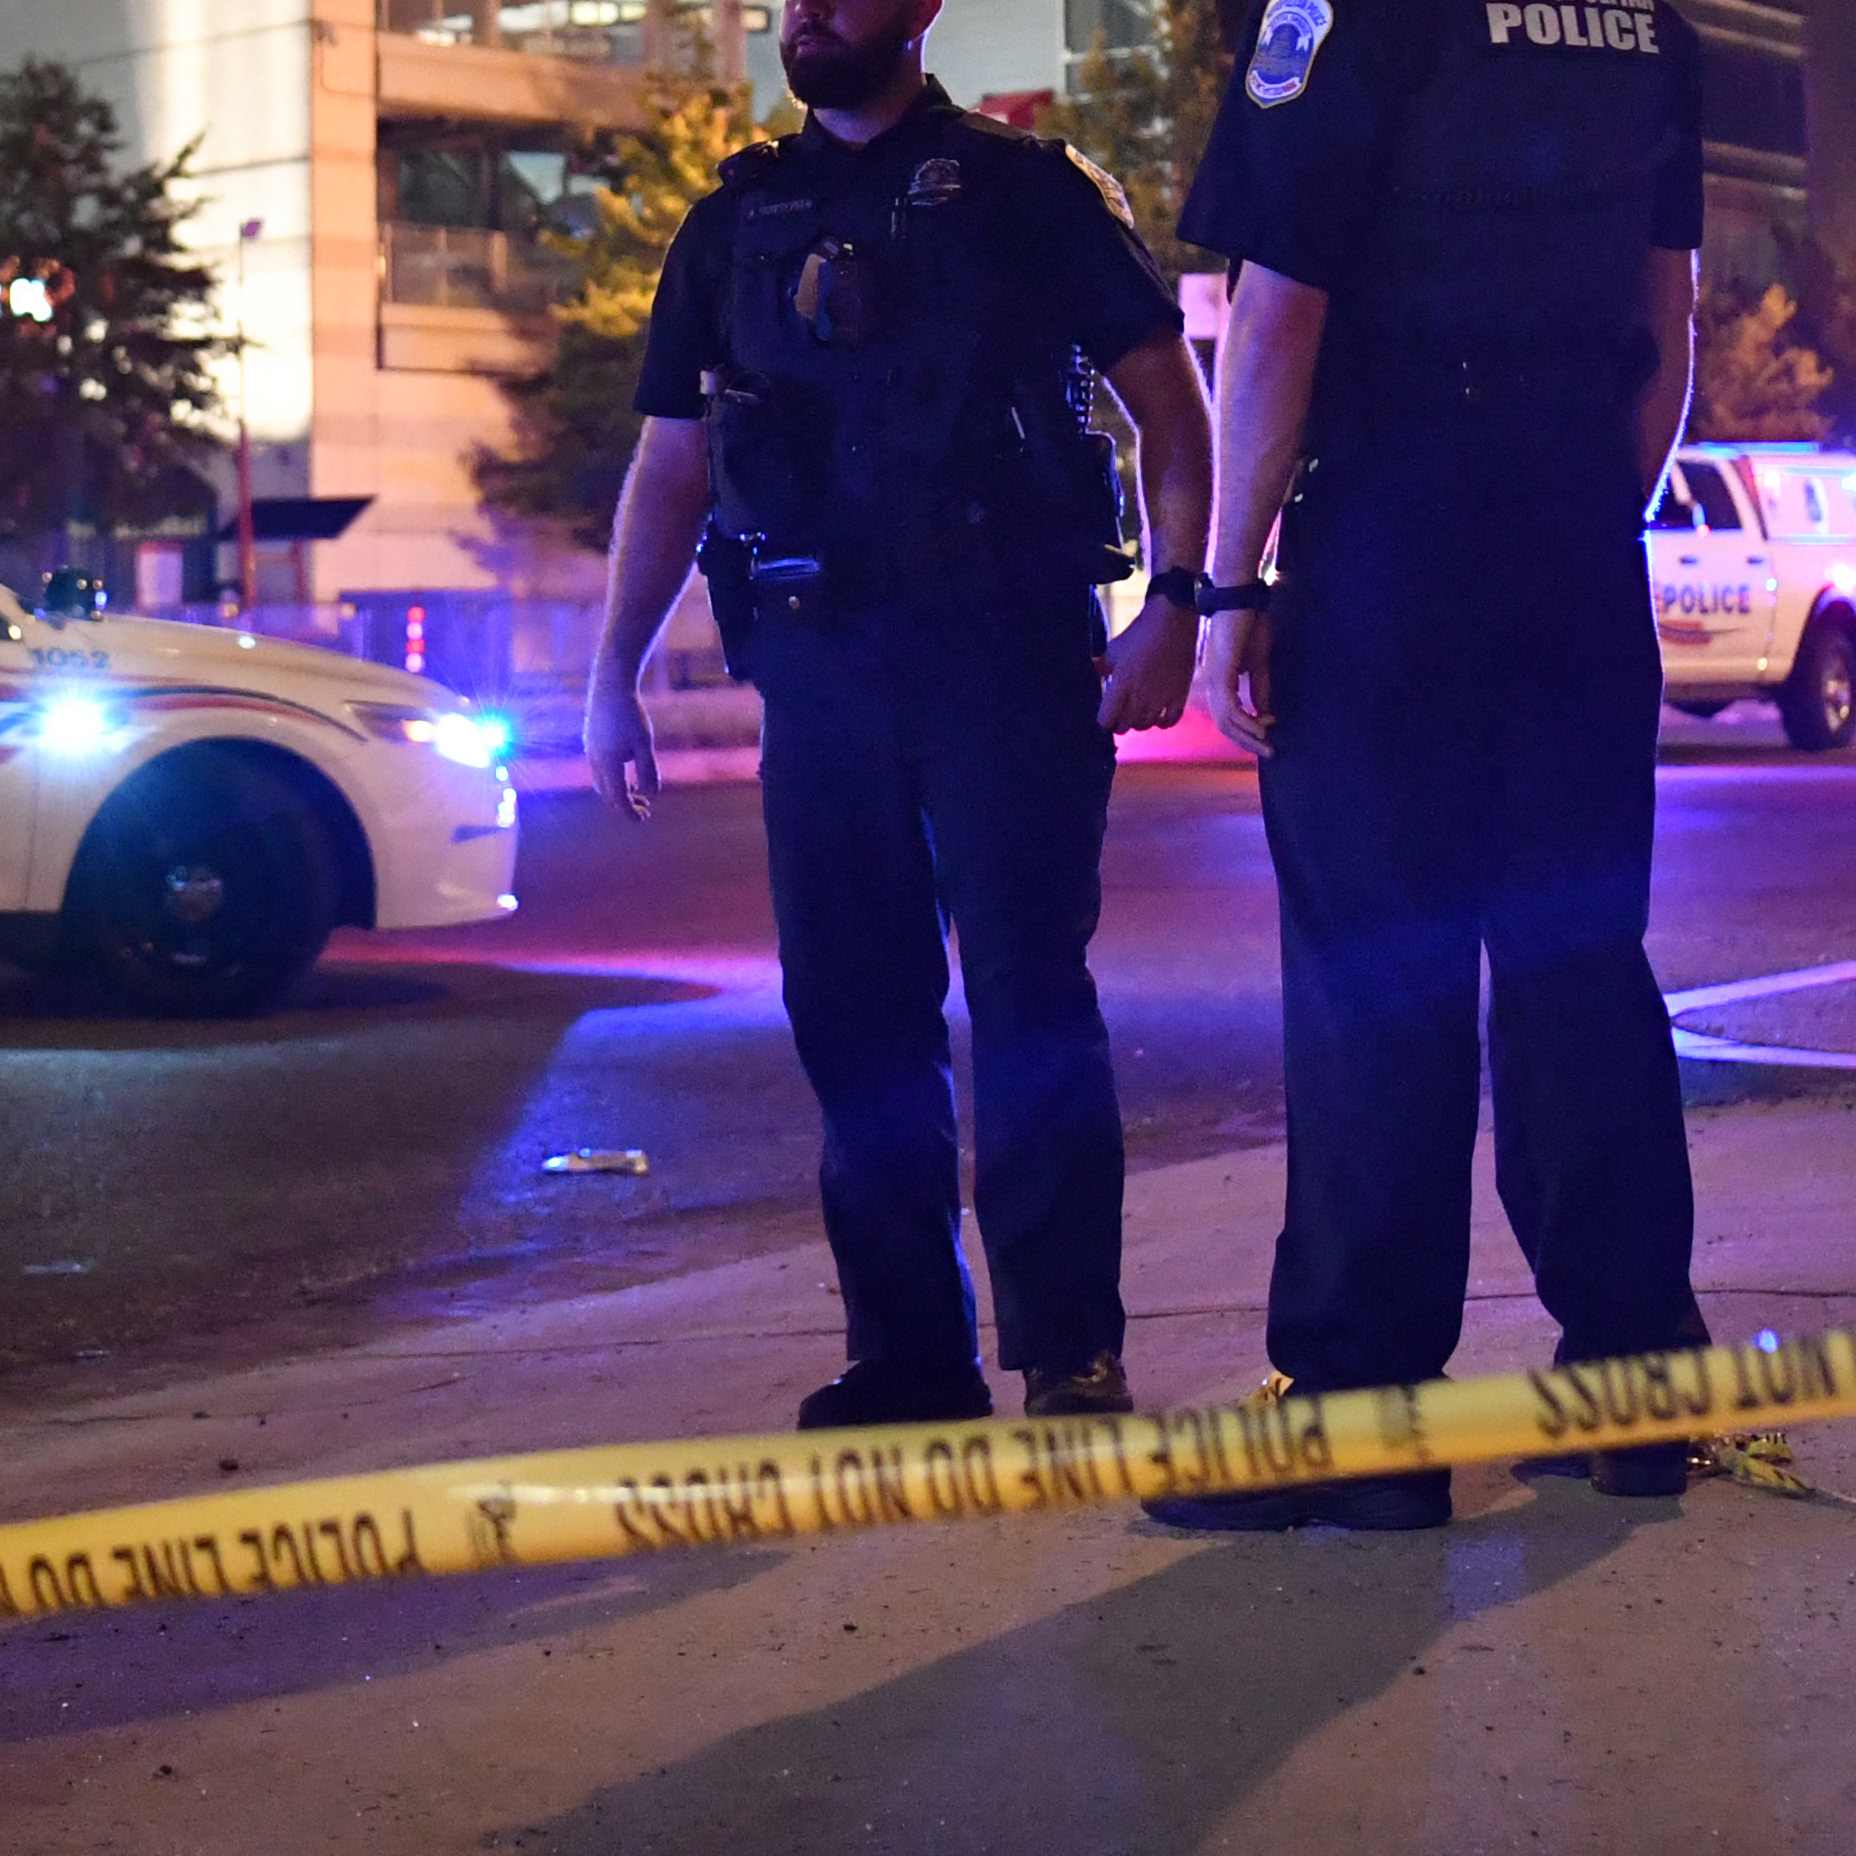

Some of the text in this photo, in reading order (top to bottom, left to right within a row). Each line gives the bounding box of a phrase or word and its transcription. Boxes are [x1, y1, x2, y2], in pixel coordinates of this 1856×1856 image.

[1485, 2, 1660, 54] POLICE
[1661, 584, 1750, 615] POLICE
[1528, 1347, 1714, 1438] CROSS
[616, 1397, 1334, 1545] POLICE LINE DO NOT CROSS
[28, 1551, 104, 1611] DO
[113, 1535, 231, 1601] LINE
[241, 1509, 422, 1592] POLICE
